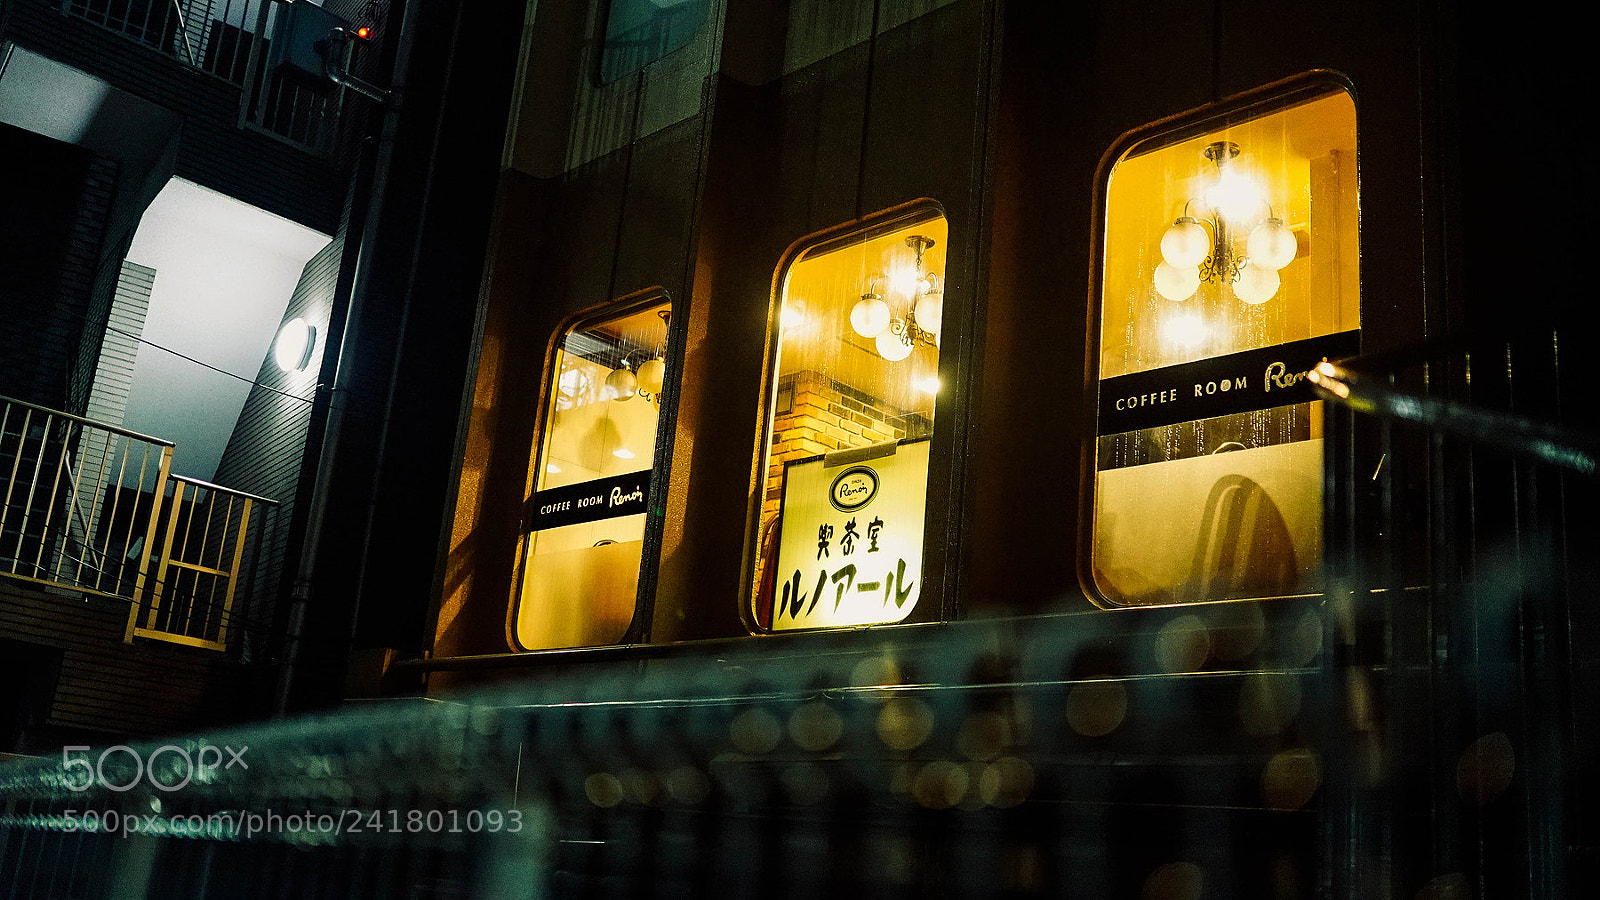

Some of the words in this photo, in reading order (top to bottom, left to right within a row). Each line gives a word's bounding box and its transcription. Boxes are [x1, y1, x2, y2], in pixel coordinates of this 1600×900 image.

[1116, 388, 1178, 412] COFFEE
[1194, 376, 1248, 398] ROOM
[1264, 357, 1329, 393] Ren
[540, 500, 571, 515] COFFEE
[577, 495, 603, 509] ROOM
[778, 558, 914, 621] ルノアール
